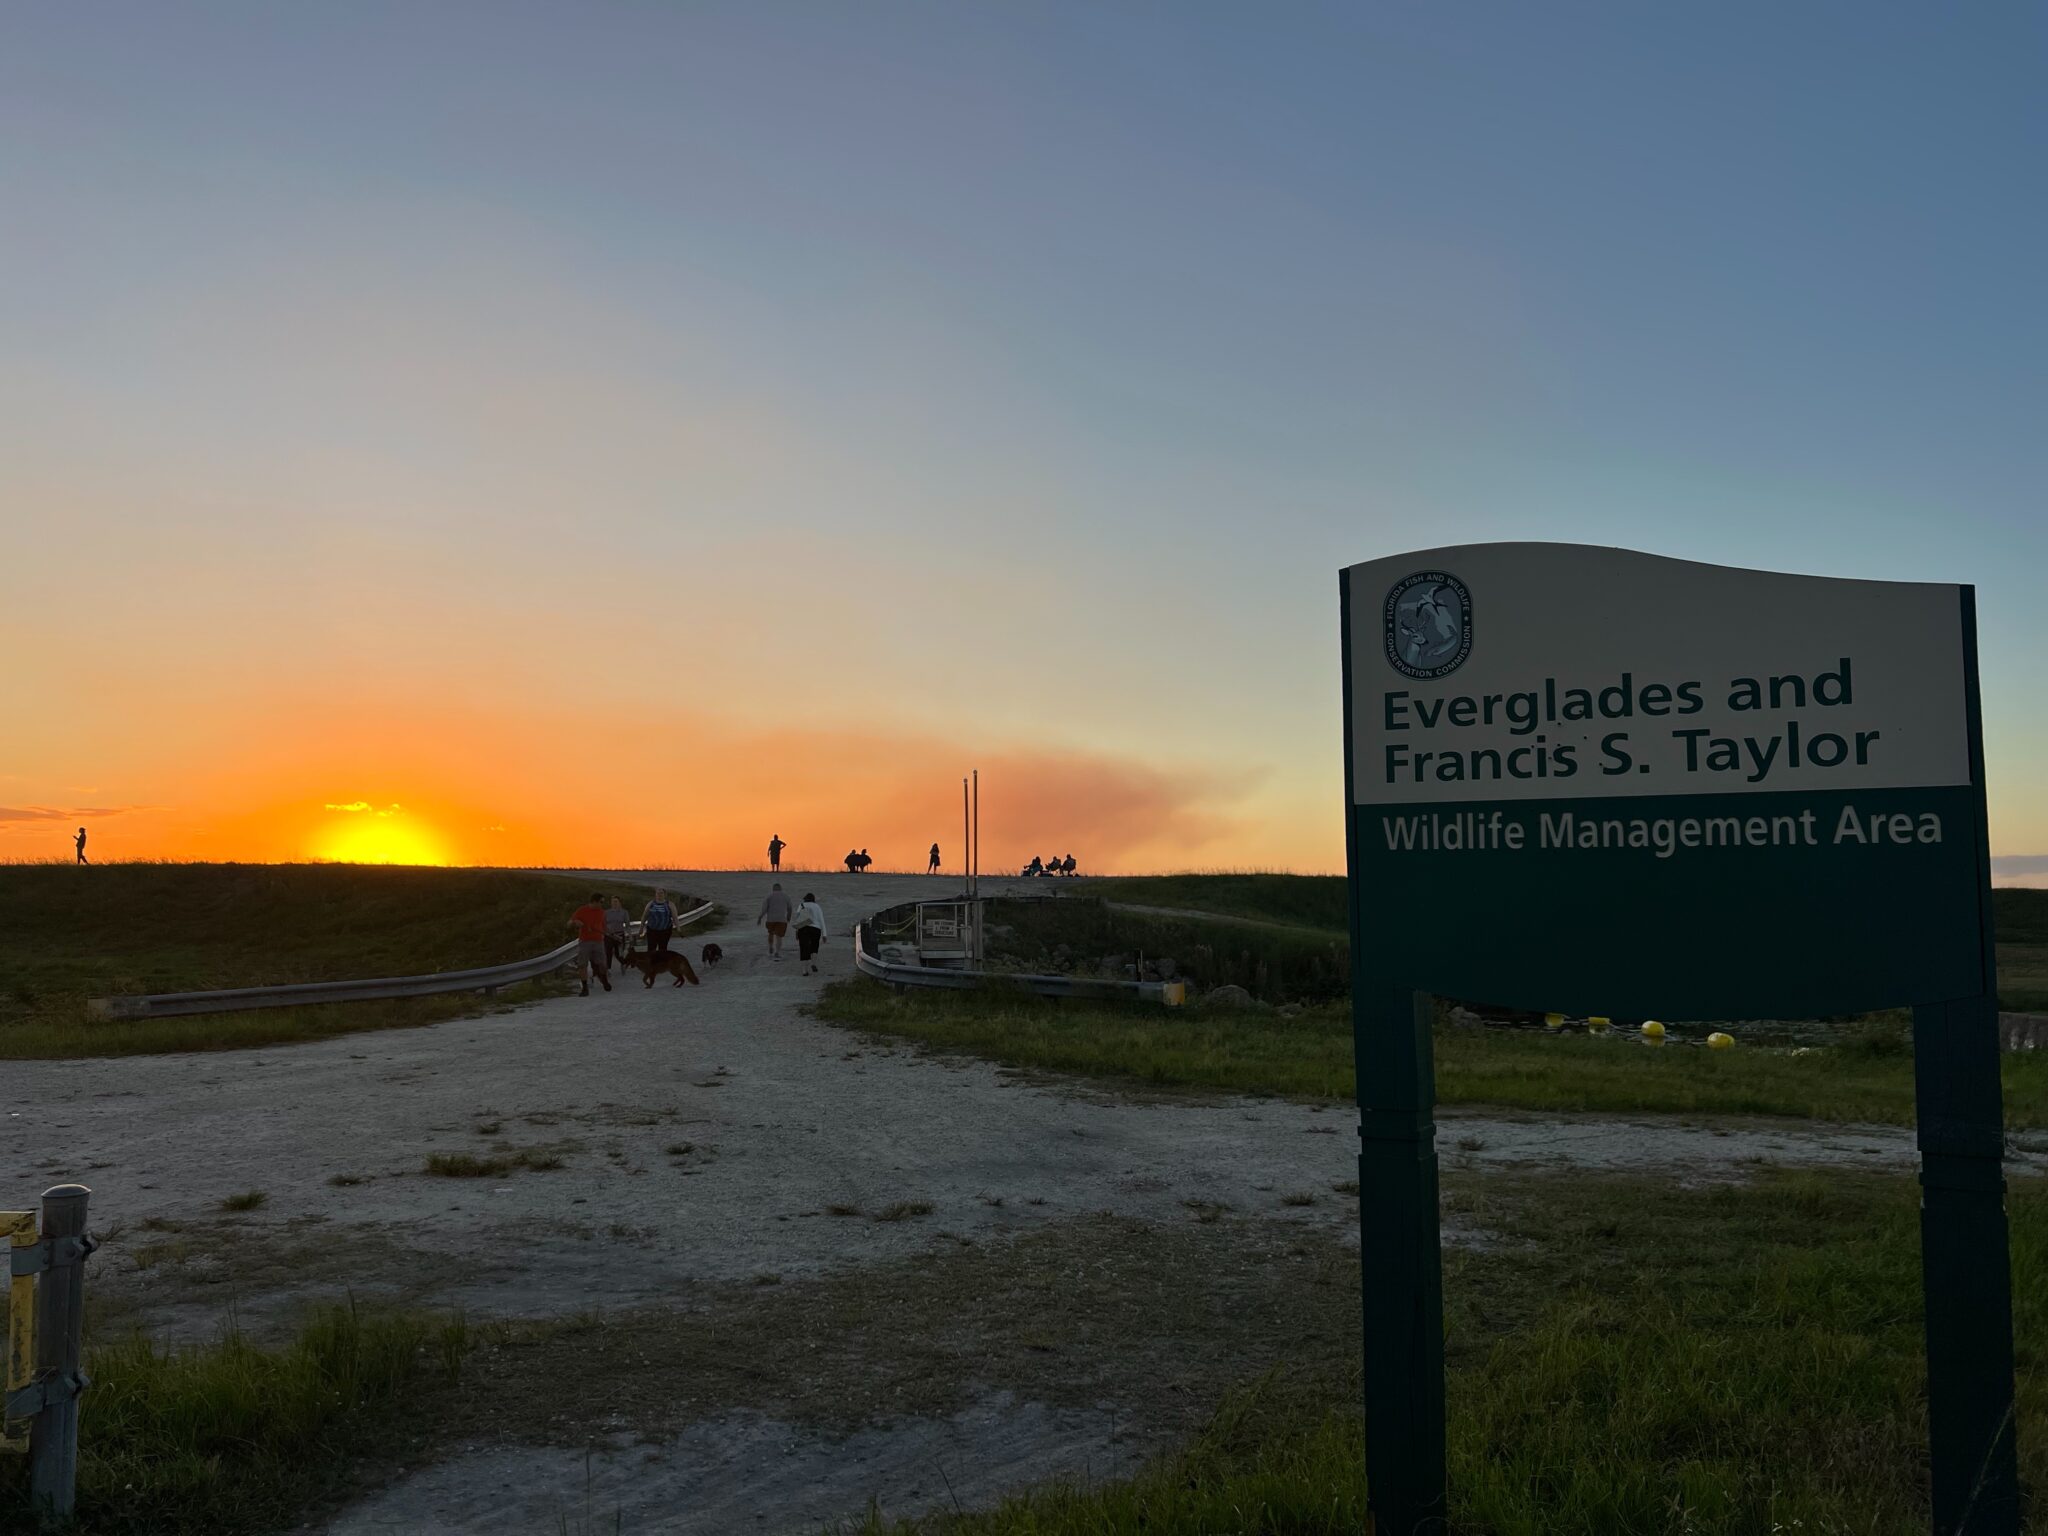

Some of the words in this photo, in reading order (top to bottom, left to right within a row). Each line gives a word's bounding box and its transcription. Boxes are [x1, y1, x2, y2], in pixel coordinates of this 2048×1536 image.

[1387, 585, 1405, 619] FLORIDA
[1405, 575, 1424, 587] FISH
[1426, 573, 1445, 582] AND
[1446, 578, 1470, 612] WILDLIFE
[1387, 632, 1432, 677] CONSERVATION
[1436, 625, 1471, 675] COMMISSION
[1384, 673, 1704, 736] Everglades
[1727, 657, 1854, 713] and
[1385, 734, 1579, 784] Francis
[1600, 732, 1650, 776] S.
[1671, 720, 1881, 783] Taylor
[1382, 811, 1526, 851] Wildlife
[1540, 809, 1818, 858] Management
[1832, 805, 1943, 845] Area
